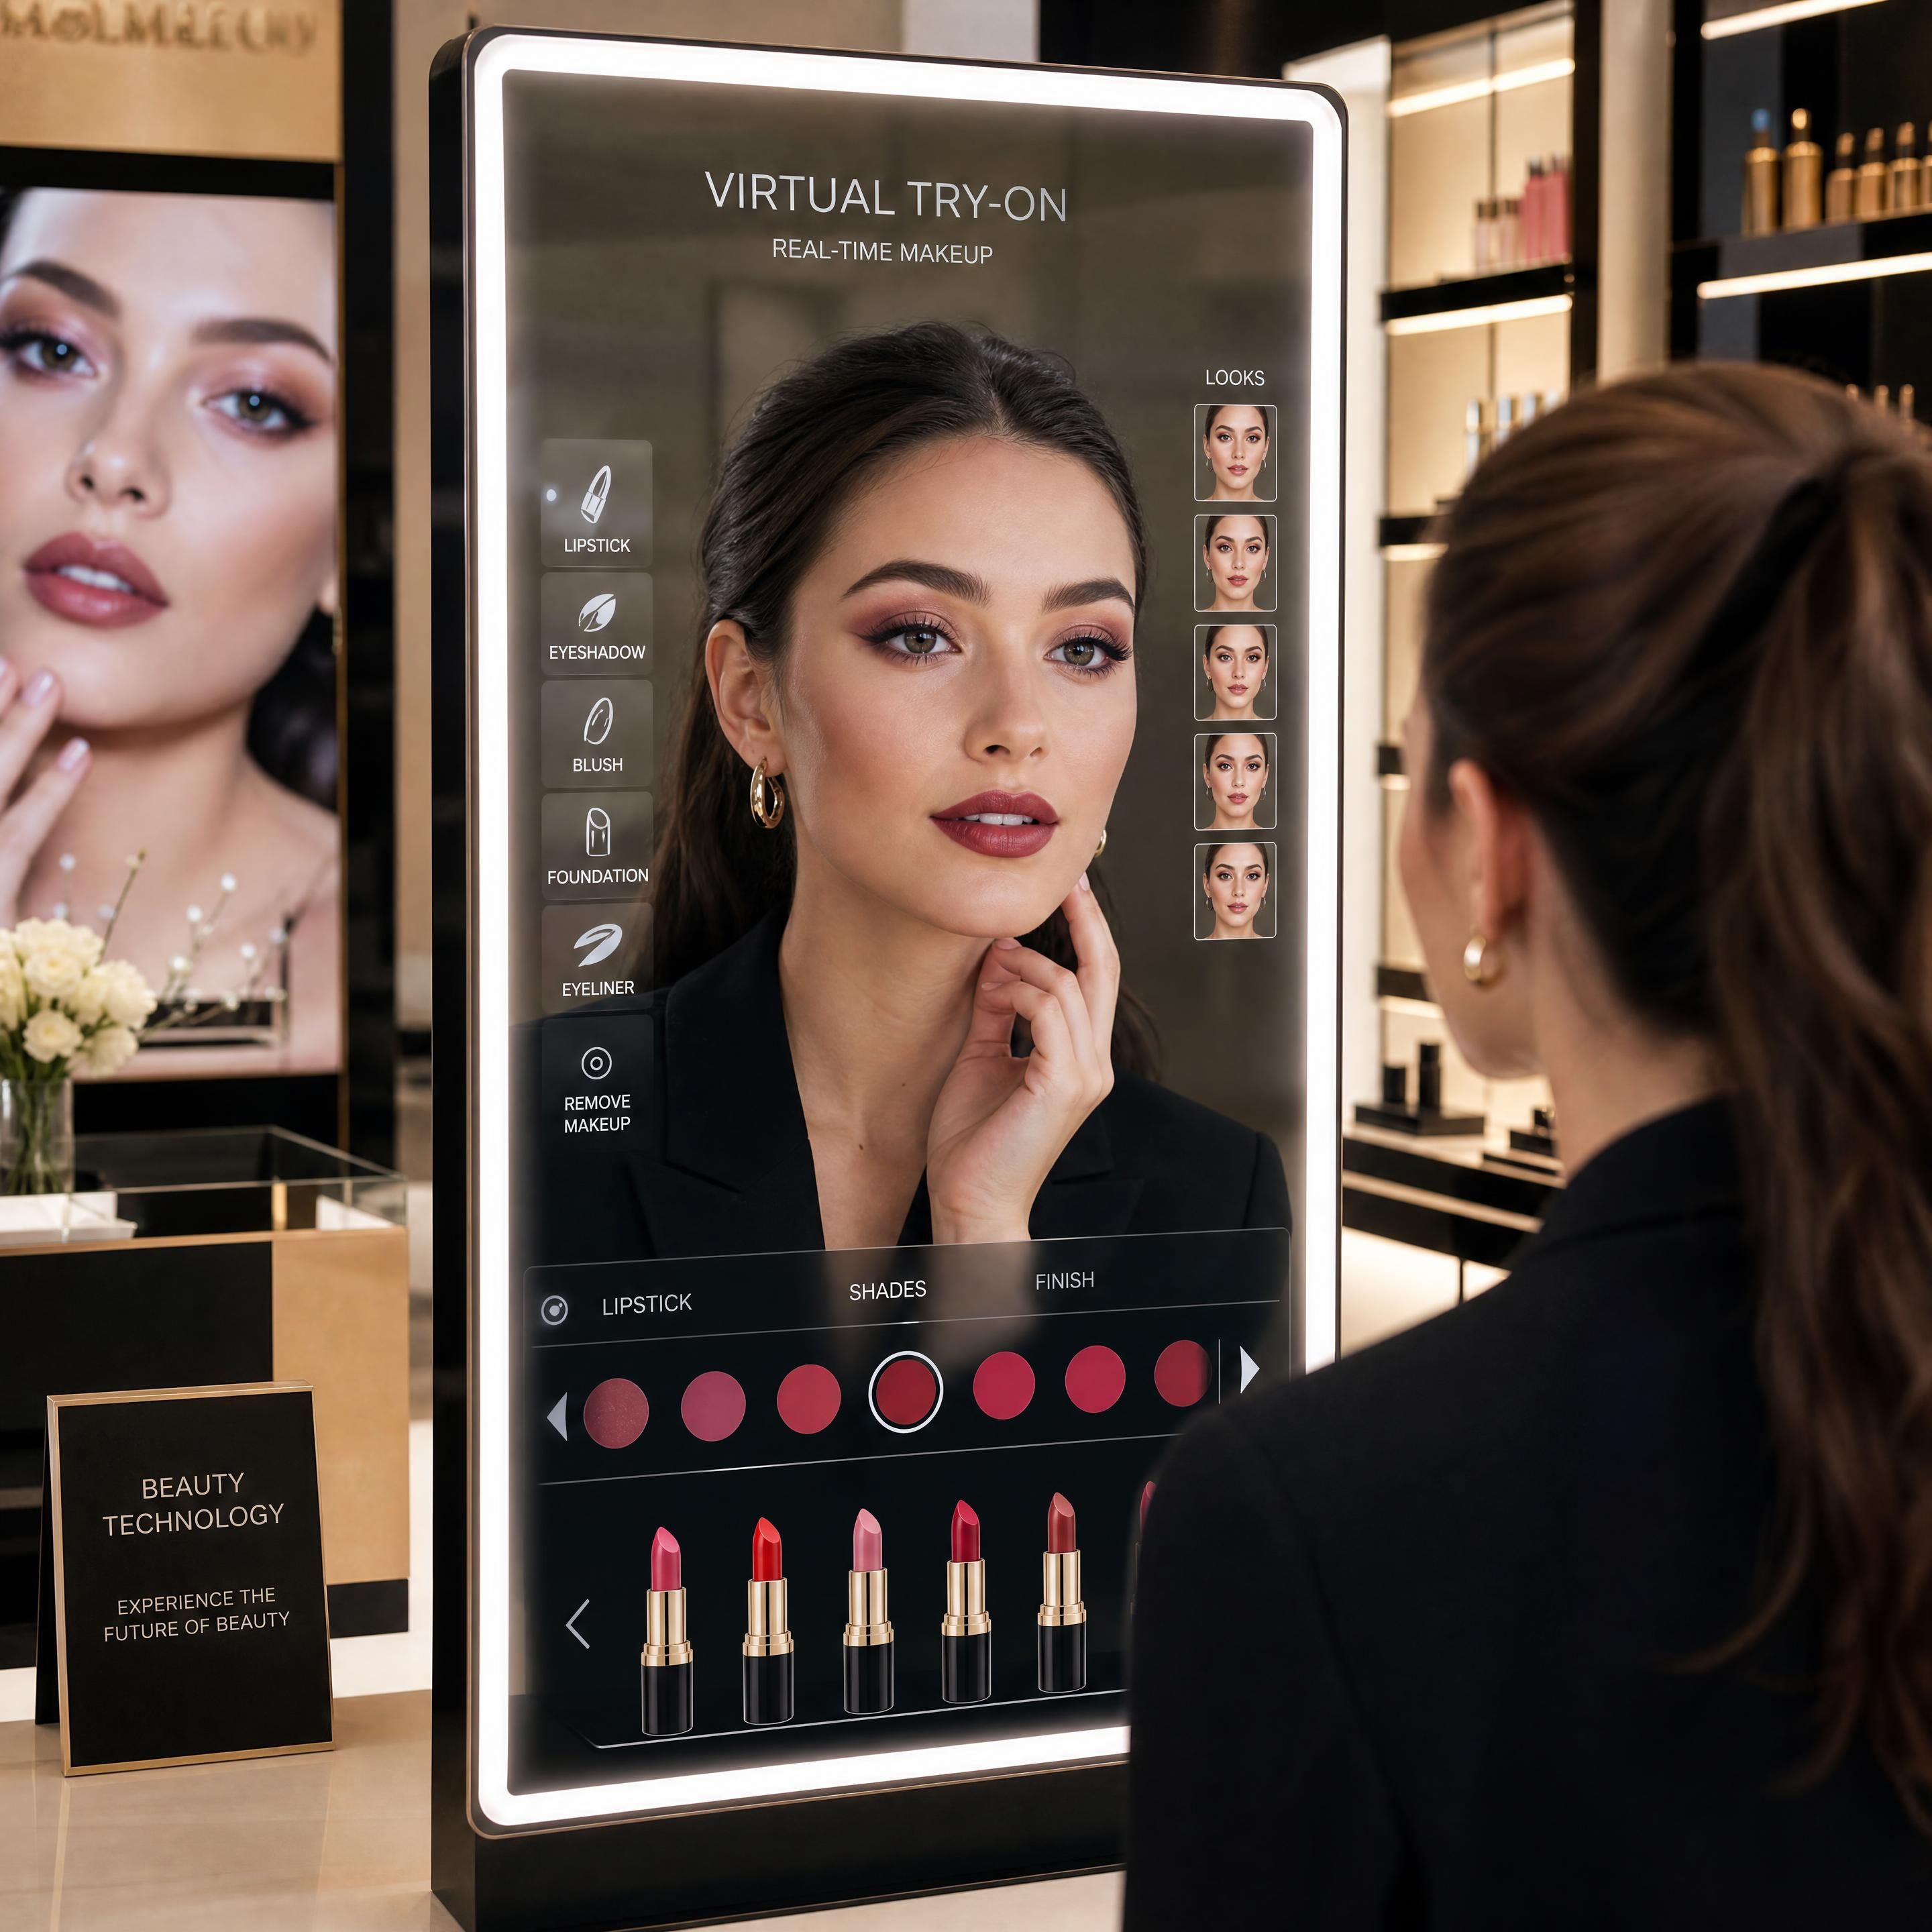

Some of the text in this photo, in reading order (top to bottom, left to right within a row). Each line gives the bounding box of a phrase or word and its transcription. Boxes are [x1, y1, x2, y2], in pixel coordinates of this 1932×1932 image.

[704, 171, 1066, 222] VIRTUAL TRY-ON
[773, 238, 993, 264] REAL-TIME MAKEUP
[1206, 369, 1265, 386] LOOKS
[564, 538, 631, 553] LIPSTICK
[549, 645, 646, 659] EYESHADOW
[573, 757, 623, 772] BLUSH
[547, 868, 649, 885] FOUNDATION
[562, 980, 635, 997] EYELINER
[565, 1094, 631, 1111] REMOVE
[564, 1116, 631, 1133] MAKEUP
[849, 1280, 926, 1301] SHADES
[1036, 1271, 1094, 1291] FINISH
[603, 1293, 692, 1316] LIPSTICK
[142, 1472, 244, 1499] BEAUTY
[102, 1503, 284, 1536] TECHNOLOGY
[117, 1587, 276, 1615] EXPERIENCE THE
[104, 1611, 290, 1642] FUTURE OF BEAUTY
